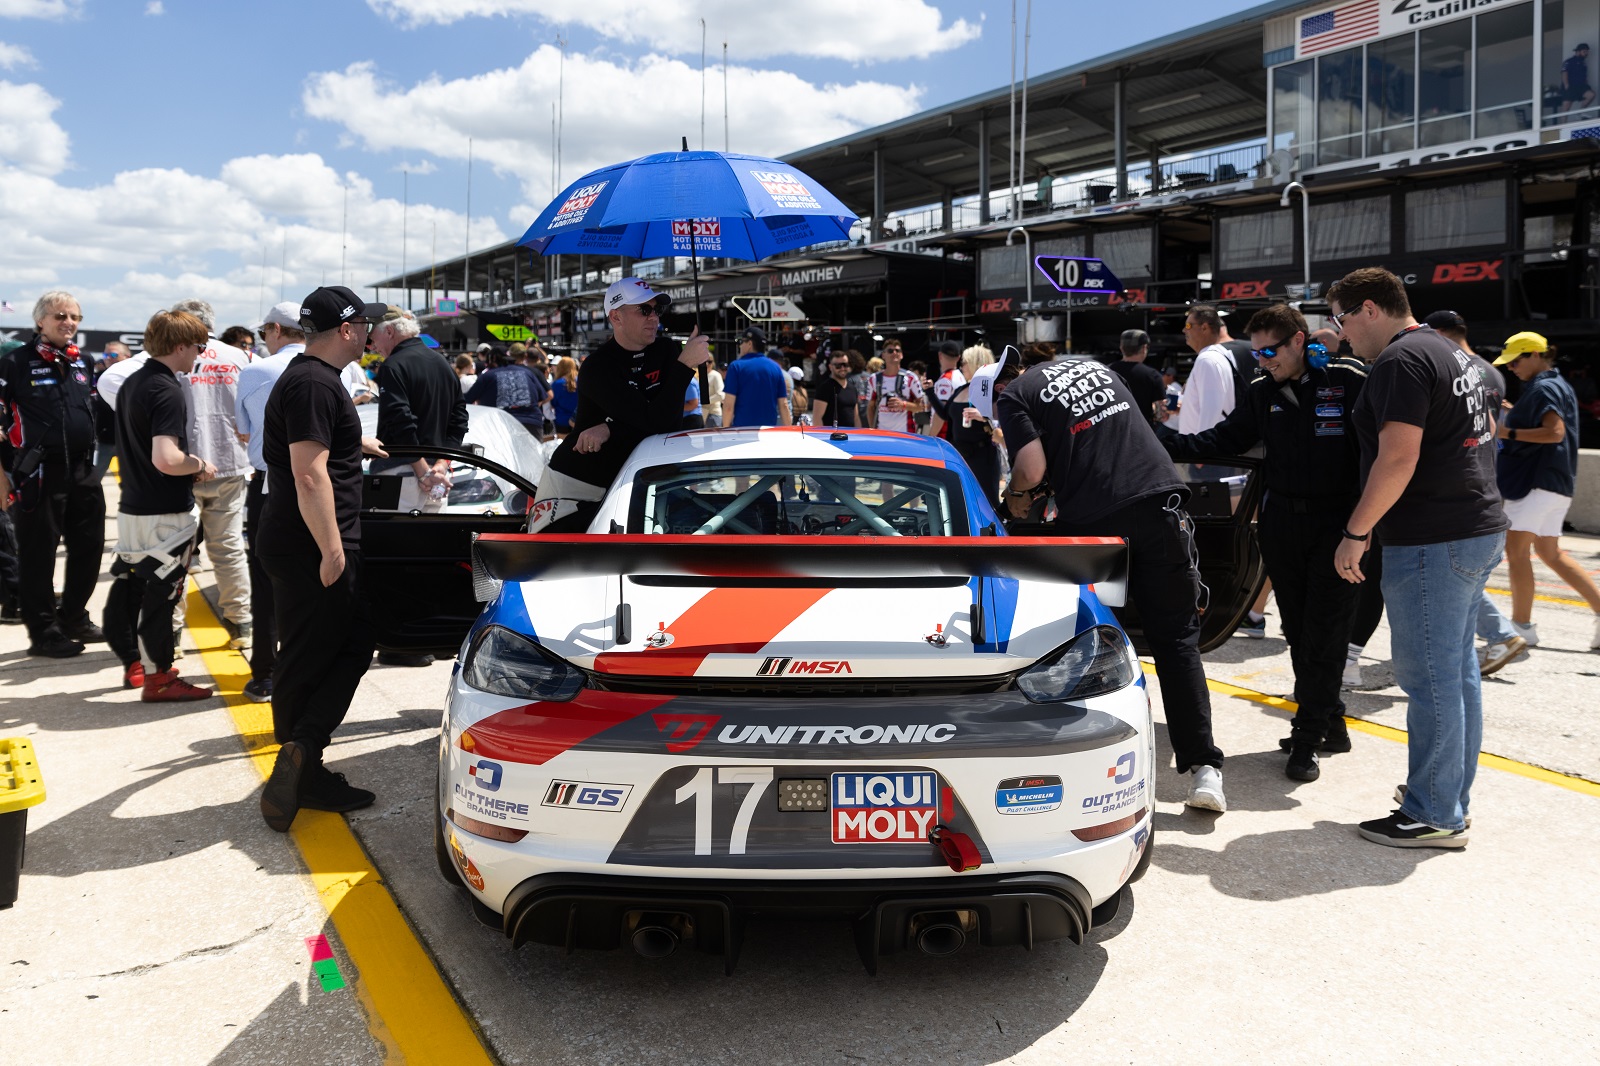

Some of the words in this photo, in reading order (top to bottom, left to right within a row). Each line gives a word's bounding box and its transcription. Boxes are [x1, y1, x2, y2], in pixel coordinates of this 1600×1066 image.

[753, 172, 799, 184] LIQUI
[570, 182, 606, 200] LIQUI
[763, 184, 807, 195] MOLY
[562, 194, 598, 212] MOLY
[674, 223, 719, 235] MOLY
[680, 243, 722, 251] ADITIVES
[781, 265, 844, 286] MANTHEY
[1054, 259, 1079, 287] 10
[1432, 260, 1503, 284] DEX
[1083, 278, 1104, 288] DEX
[1220, 280, 1271, 299] DEX
[746, 299, 769, 317] 40
[980, 298, 1013, 313] DEX
[1047, 296, 1099, 308] CADLLAC
[502, 326, 523, 339] 911
[202, 364, 238, 374] IMSA
[1041, 359, 1081, 381] ANTI
[191, 375, 234, 385] PHOTO
[1057, 370, 1113, 409] PARTS
[1071, 388, 1116, 417] SHOP
[788, 661, 853, 674] IMSA
[717, 723, 957, 745] UNITRONIC
[455, 783, 475, 802] OUT
[476, 795, 529, 815] THERE
[576, 787, 624, 807] GS
[838, 775, 931, 807] LIQUI
[1018, 792, 1054, 800] MICHELIN
[1082, 793, 1114, 808] OUT
[1115, 778, 1145, 802] THERE
[467, 802, 507, 820] BRANDS
[675, 766, 774, 856] 17
[1023, 804, 1053, 812] CHALLENGE
[1101, 797, 1136, 814] BRANDS
[838, 811, 935, 839] MOLY
